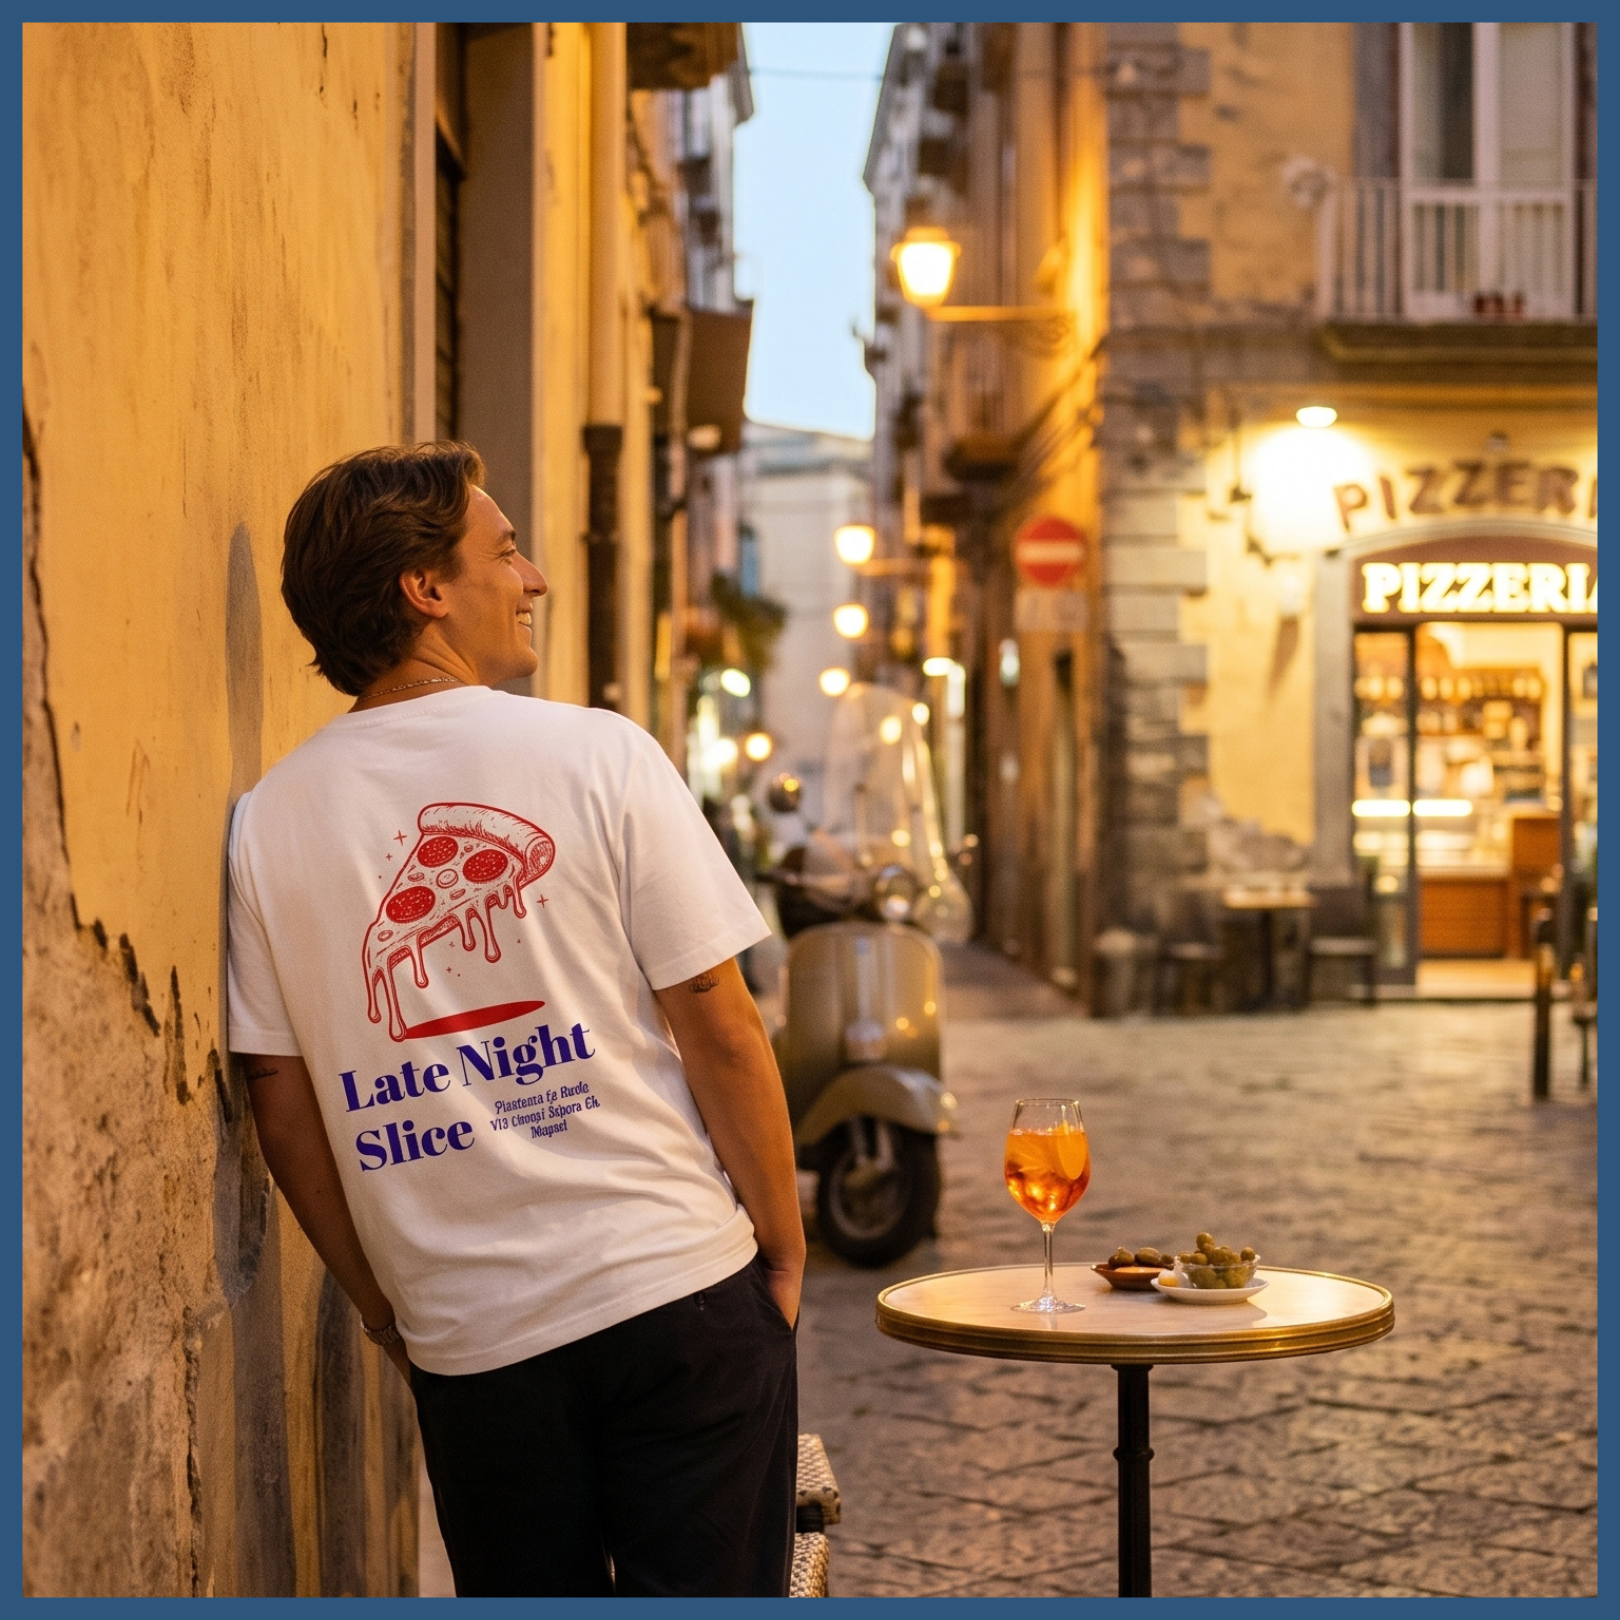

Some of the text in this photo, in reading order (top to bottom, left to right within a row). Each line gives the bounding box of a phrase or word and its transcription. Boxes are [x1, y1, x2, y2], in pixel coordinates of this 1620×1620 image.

[1361, 562, 1598, 614] PIZZERI
[338, 1023, 595, 1112] Late Night
[355, 1119, 475, 1172] Slice
